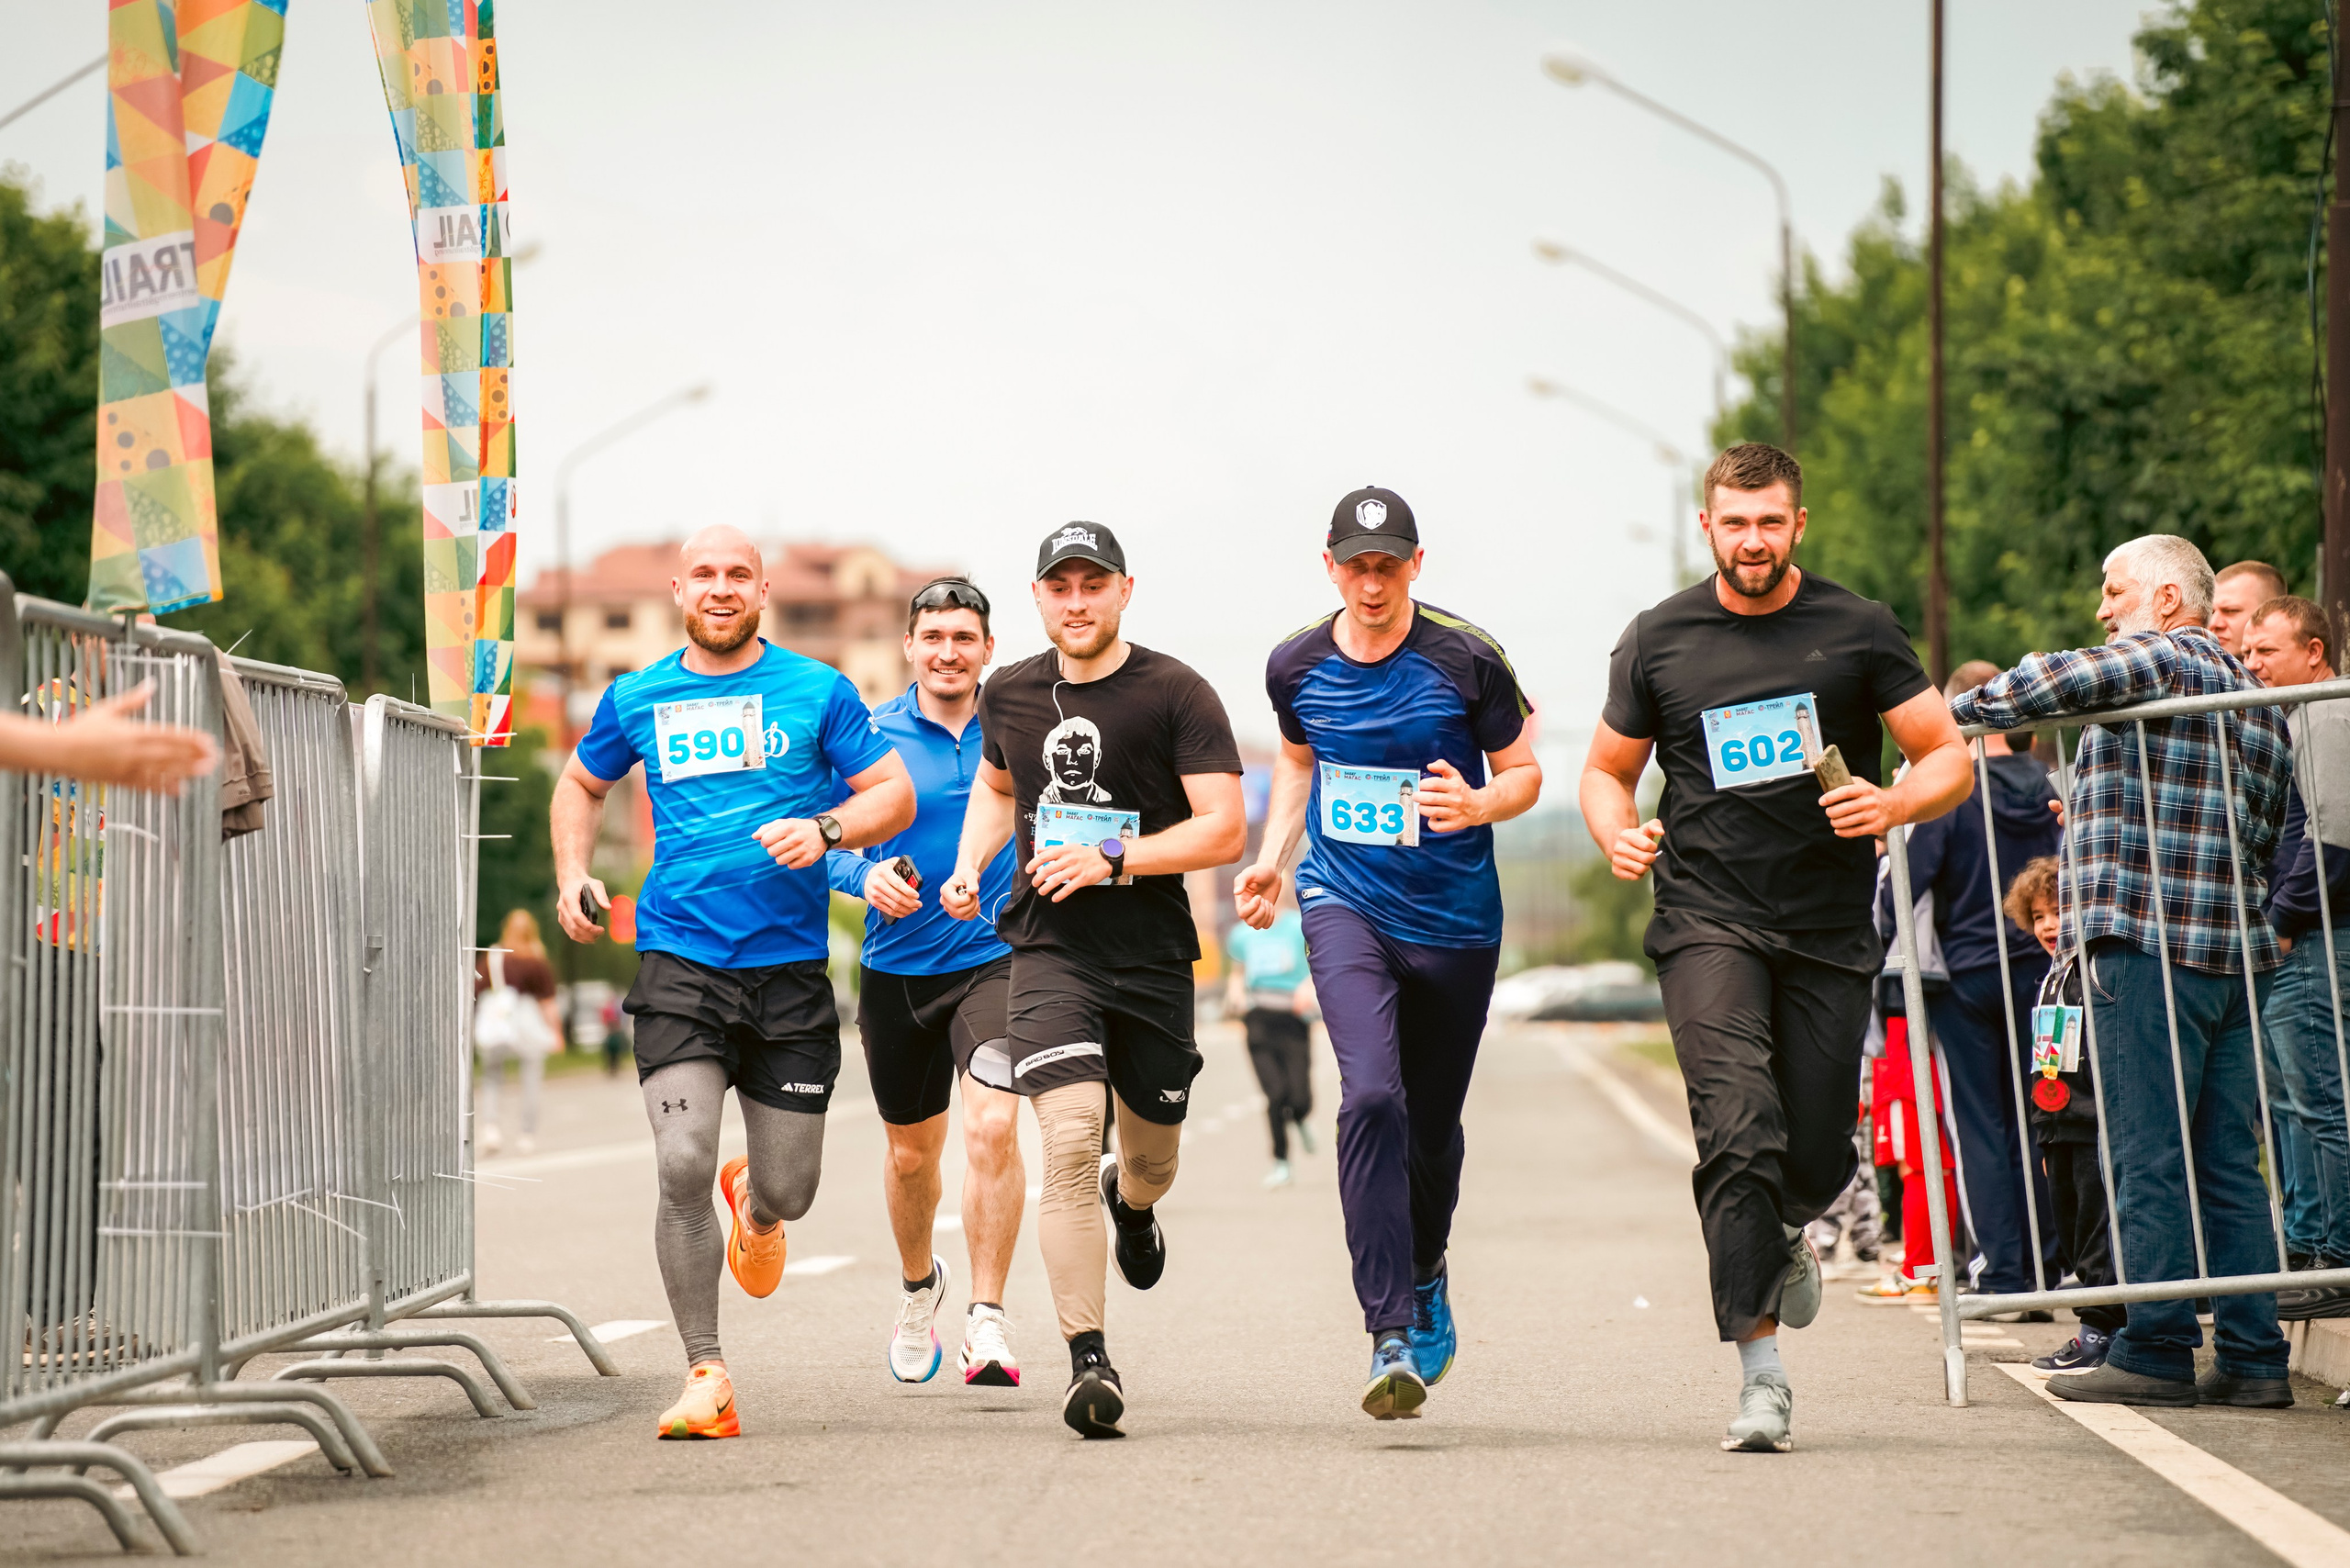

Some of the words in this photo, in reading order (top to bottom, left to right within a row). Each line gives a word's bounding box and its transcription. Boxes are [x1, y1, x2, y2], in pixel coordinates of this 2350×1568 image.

[1051, 533, 1098, 555] LONSDALE
[668, 726, 745, 765] 590
[1720, 729, 1805, 773] 602
[1331, 799, 1404, 834] 633
[1024, 1056, 1043, 1067] BAD
[1043, 1049, 1065, 1059] BOY
[793, 1082, 824, 1094] TERREX
